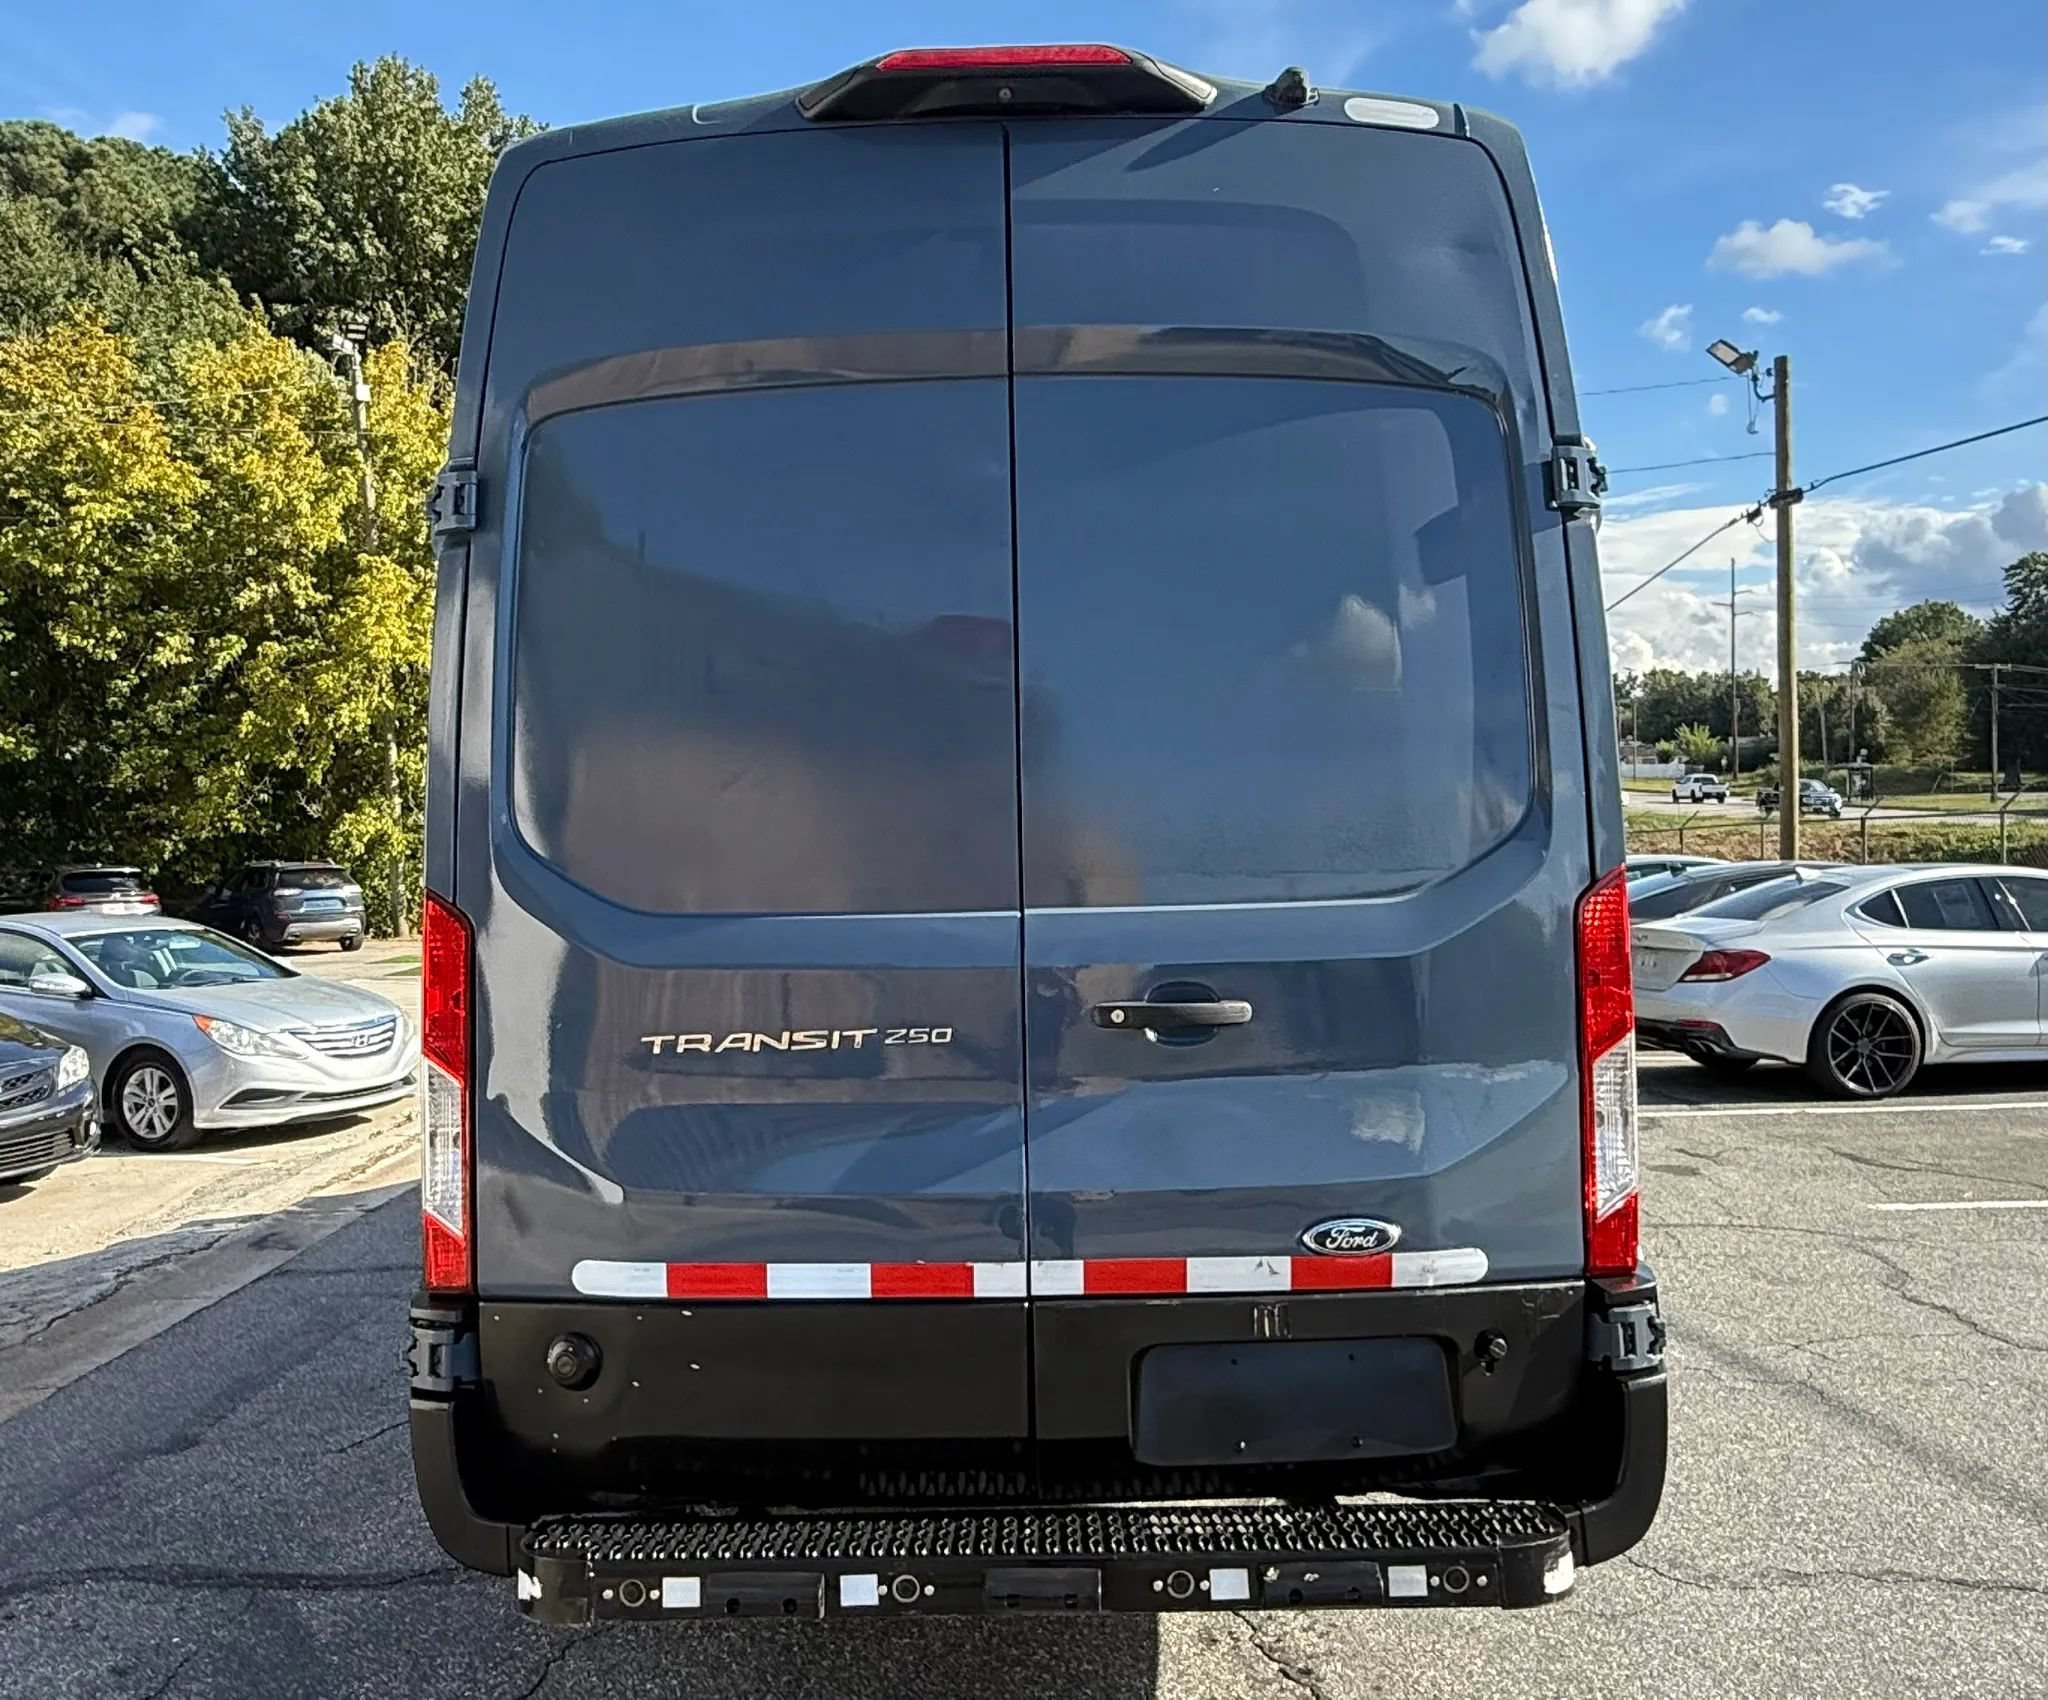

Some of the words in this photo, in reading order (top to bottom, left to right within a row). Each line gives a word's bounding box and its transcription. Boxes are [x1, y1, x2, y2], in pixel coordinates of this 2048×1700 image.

[640, 1028, 878, 1055] TRANSIT
[884, 1027, 954, 1045] 250
[1325, 1226, 1379, 1249] Ford
